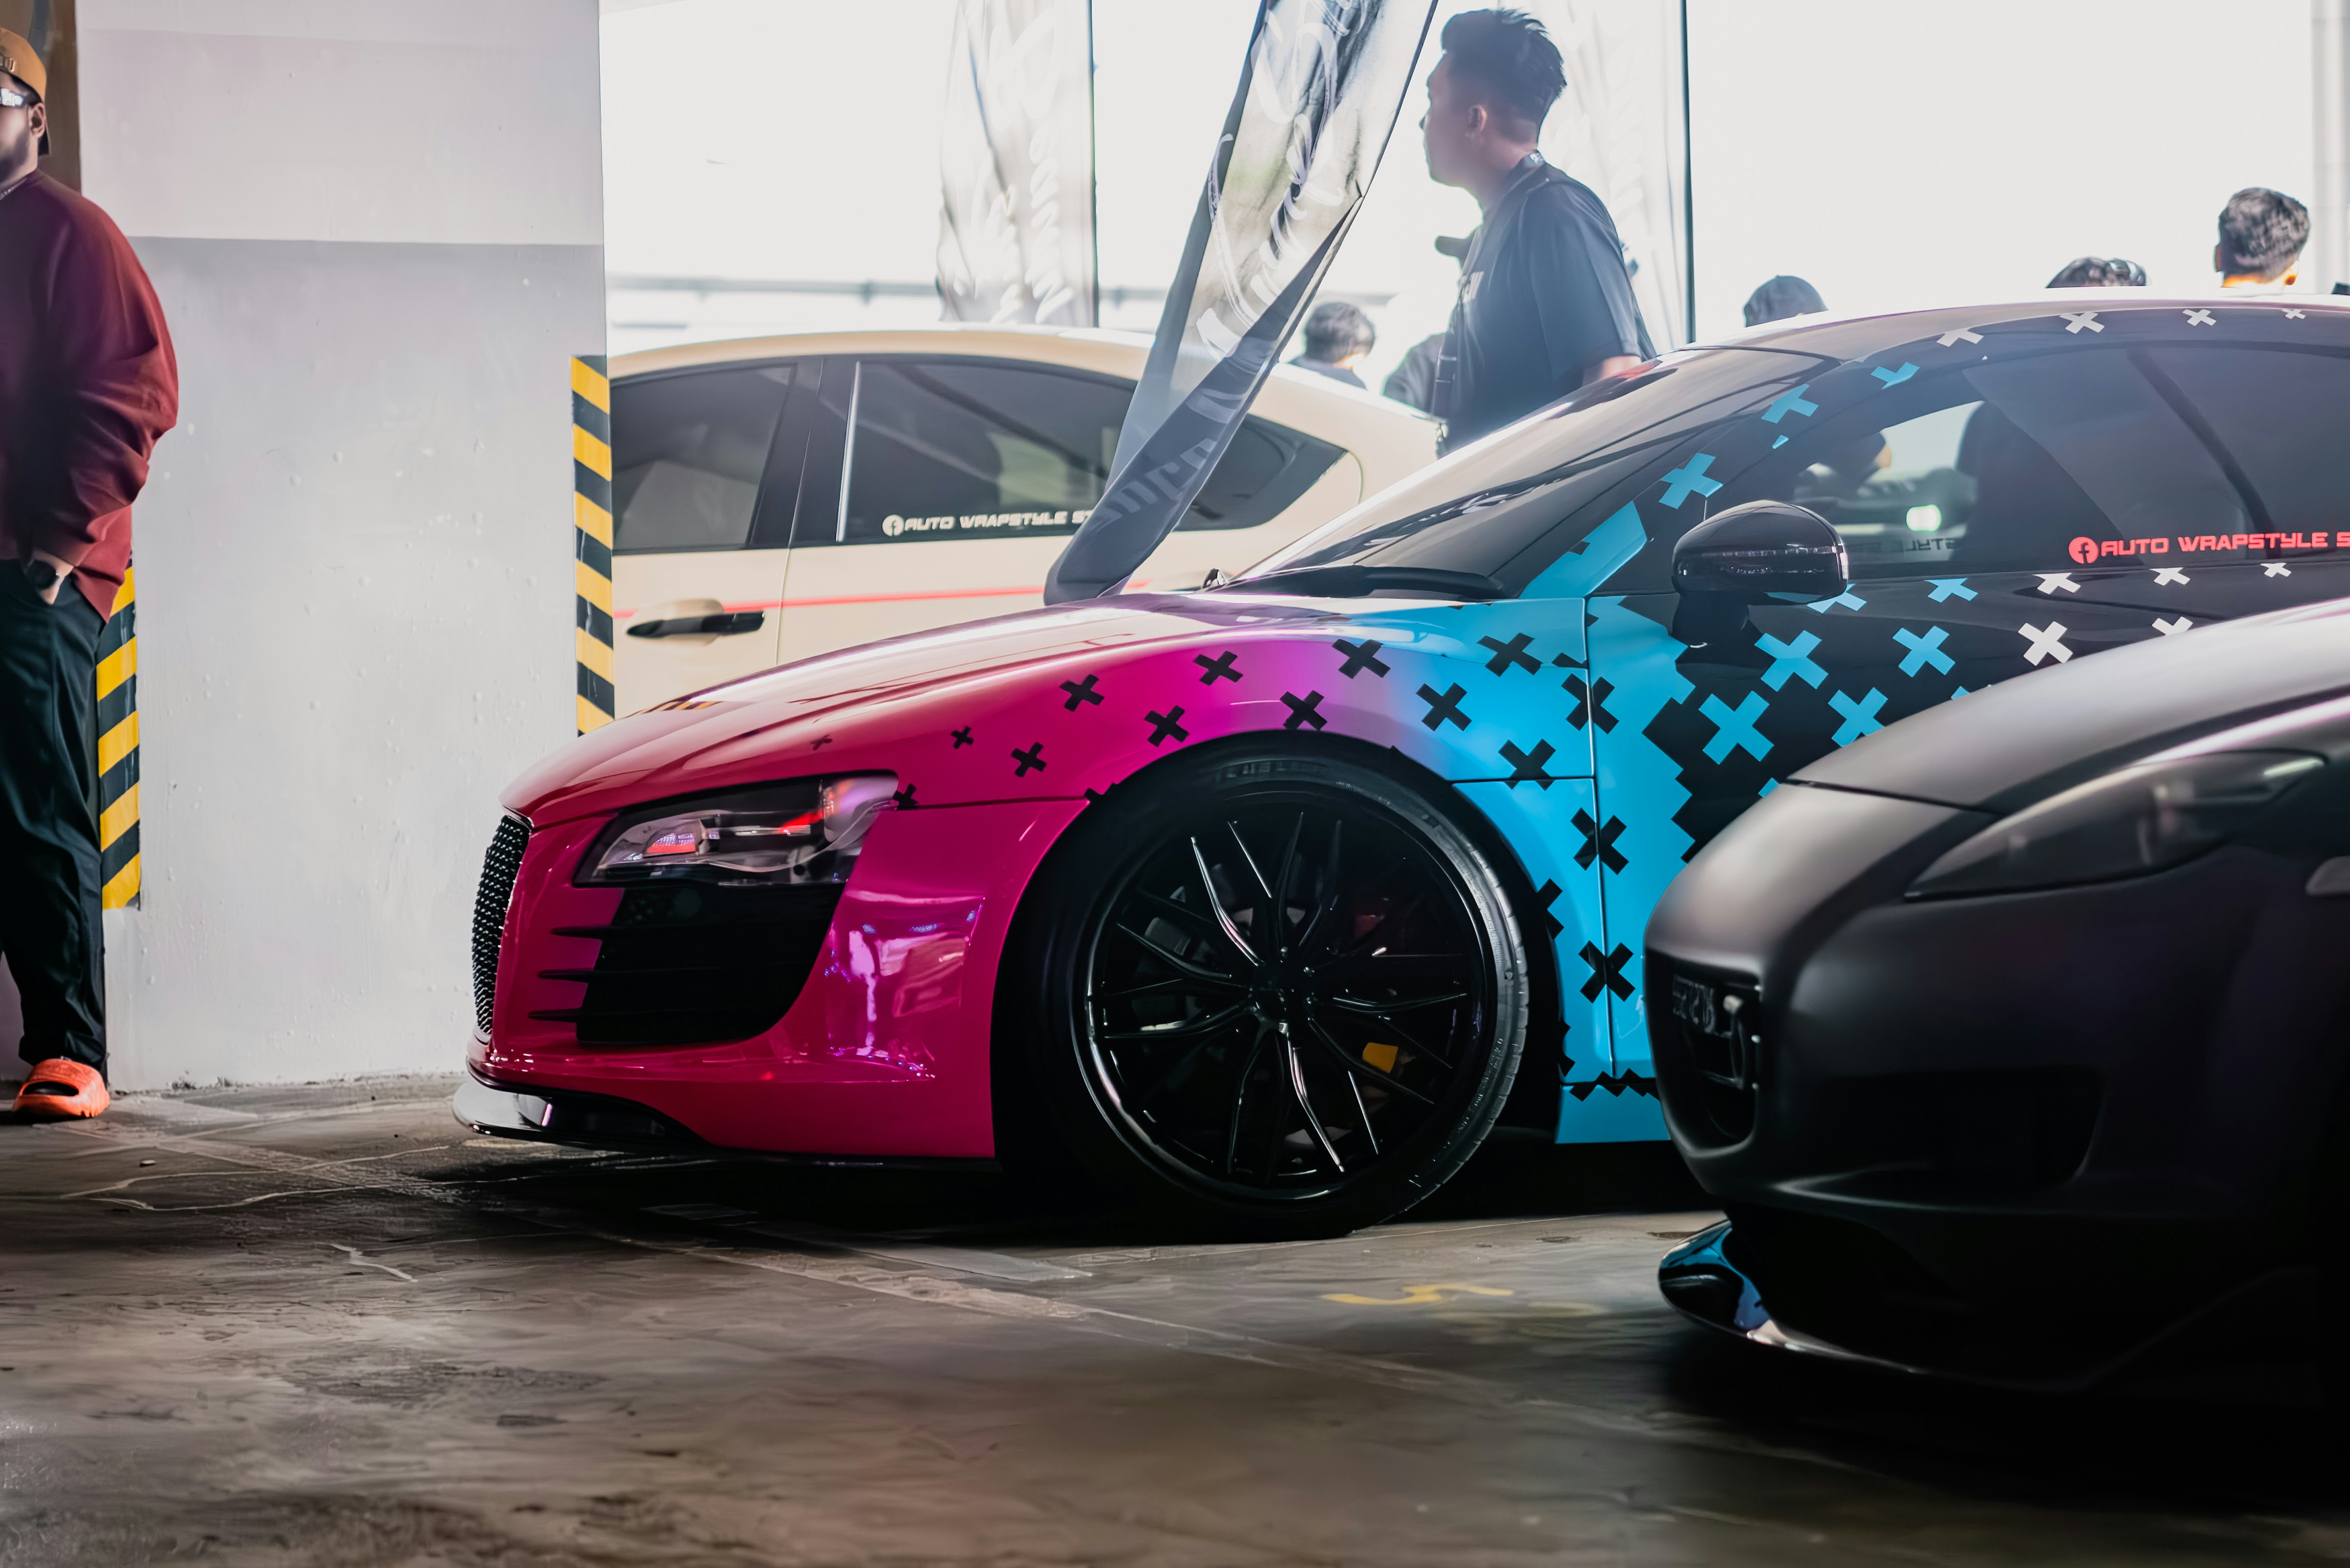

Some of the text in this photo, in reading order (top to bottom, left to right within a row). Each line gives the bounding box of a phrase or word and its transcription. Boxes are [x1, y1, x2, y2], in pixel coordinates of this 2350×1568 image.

[904, 516, 954, 531] AUTO
[960, 510, 1067, 528] WRAPSTYLE
[2101, 537, 2169, 556] AUTO
[2178, 532, 2329, 552] WRAPSTYLE
